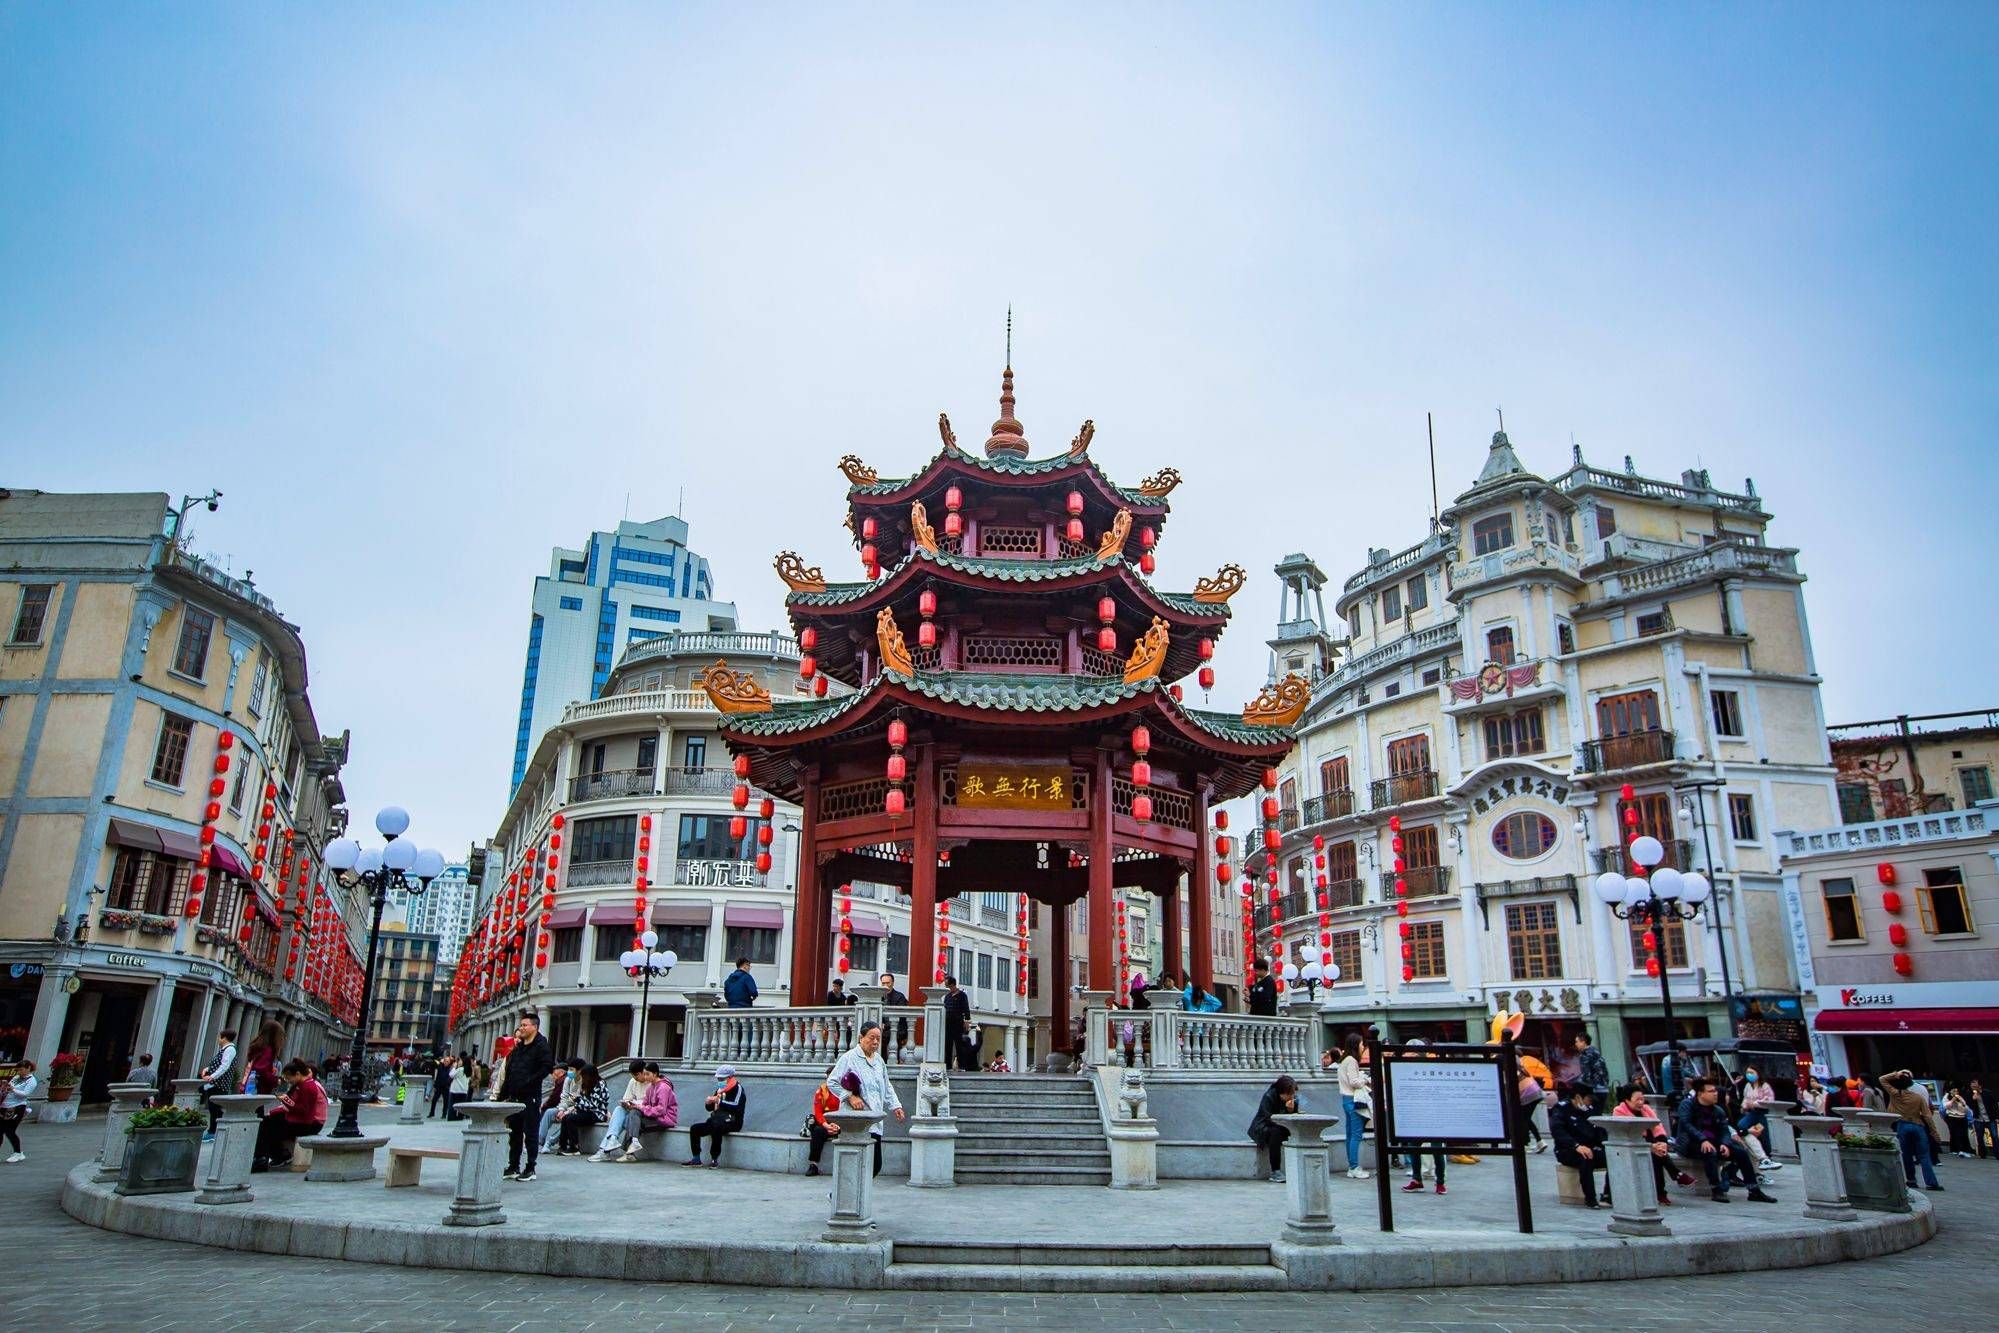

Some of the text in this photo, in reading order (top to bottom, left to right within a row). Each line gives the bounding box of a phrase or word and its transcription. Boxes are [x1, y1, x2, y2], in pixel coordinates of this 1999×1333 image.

[685, 859, 755, 888] 潮宏基
[108, 952, 147, 968] Coffee
